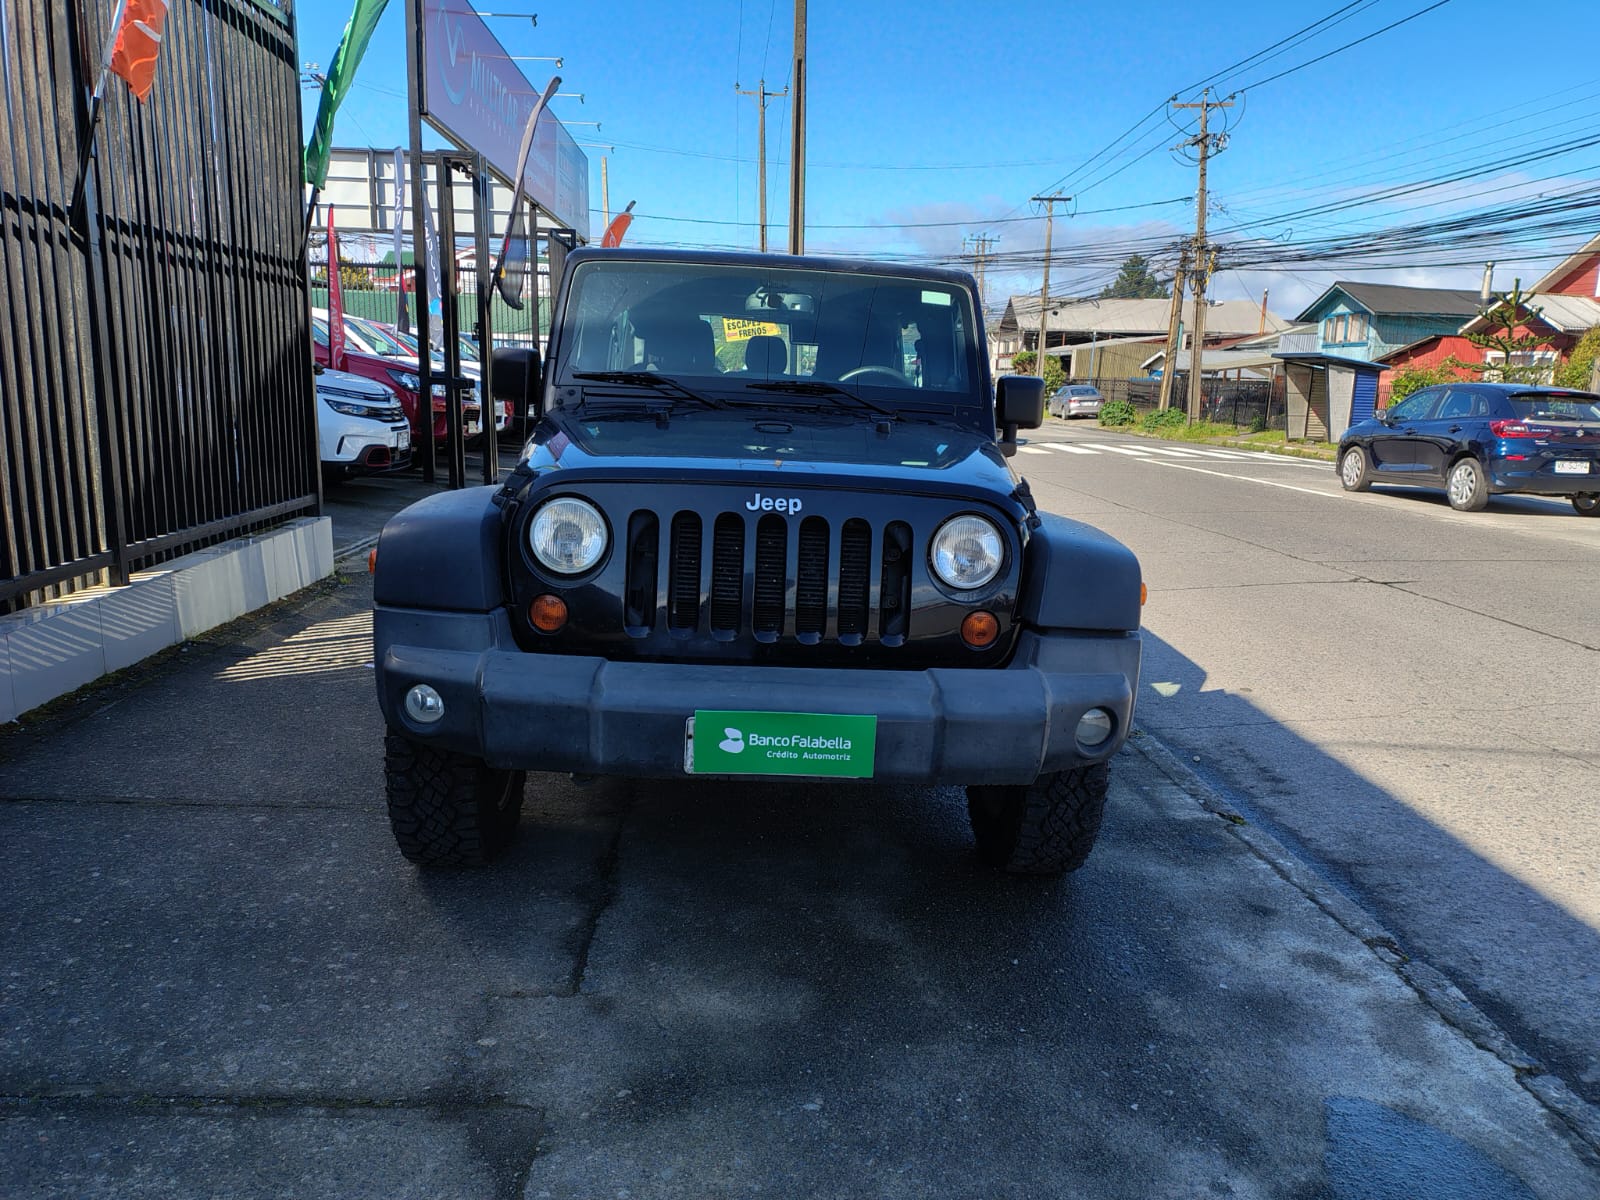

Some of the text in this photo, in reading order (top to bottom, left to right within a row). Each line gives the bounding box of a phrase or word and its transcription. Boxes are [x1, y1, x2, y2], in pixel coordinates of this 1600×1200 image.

[738, 327, 767, 338] FRENOS
[746, 493, 802, 515] Jeep
[791, 735, 851, 750] Falabella
[766, 750, 851, 761] Crédito Automotriz
